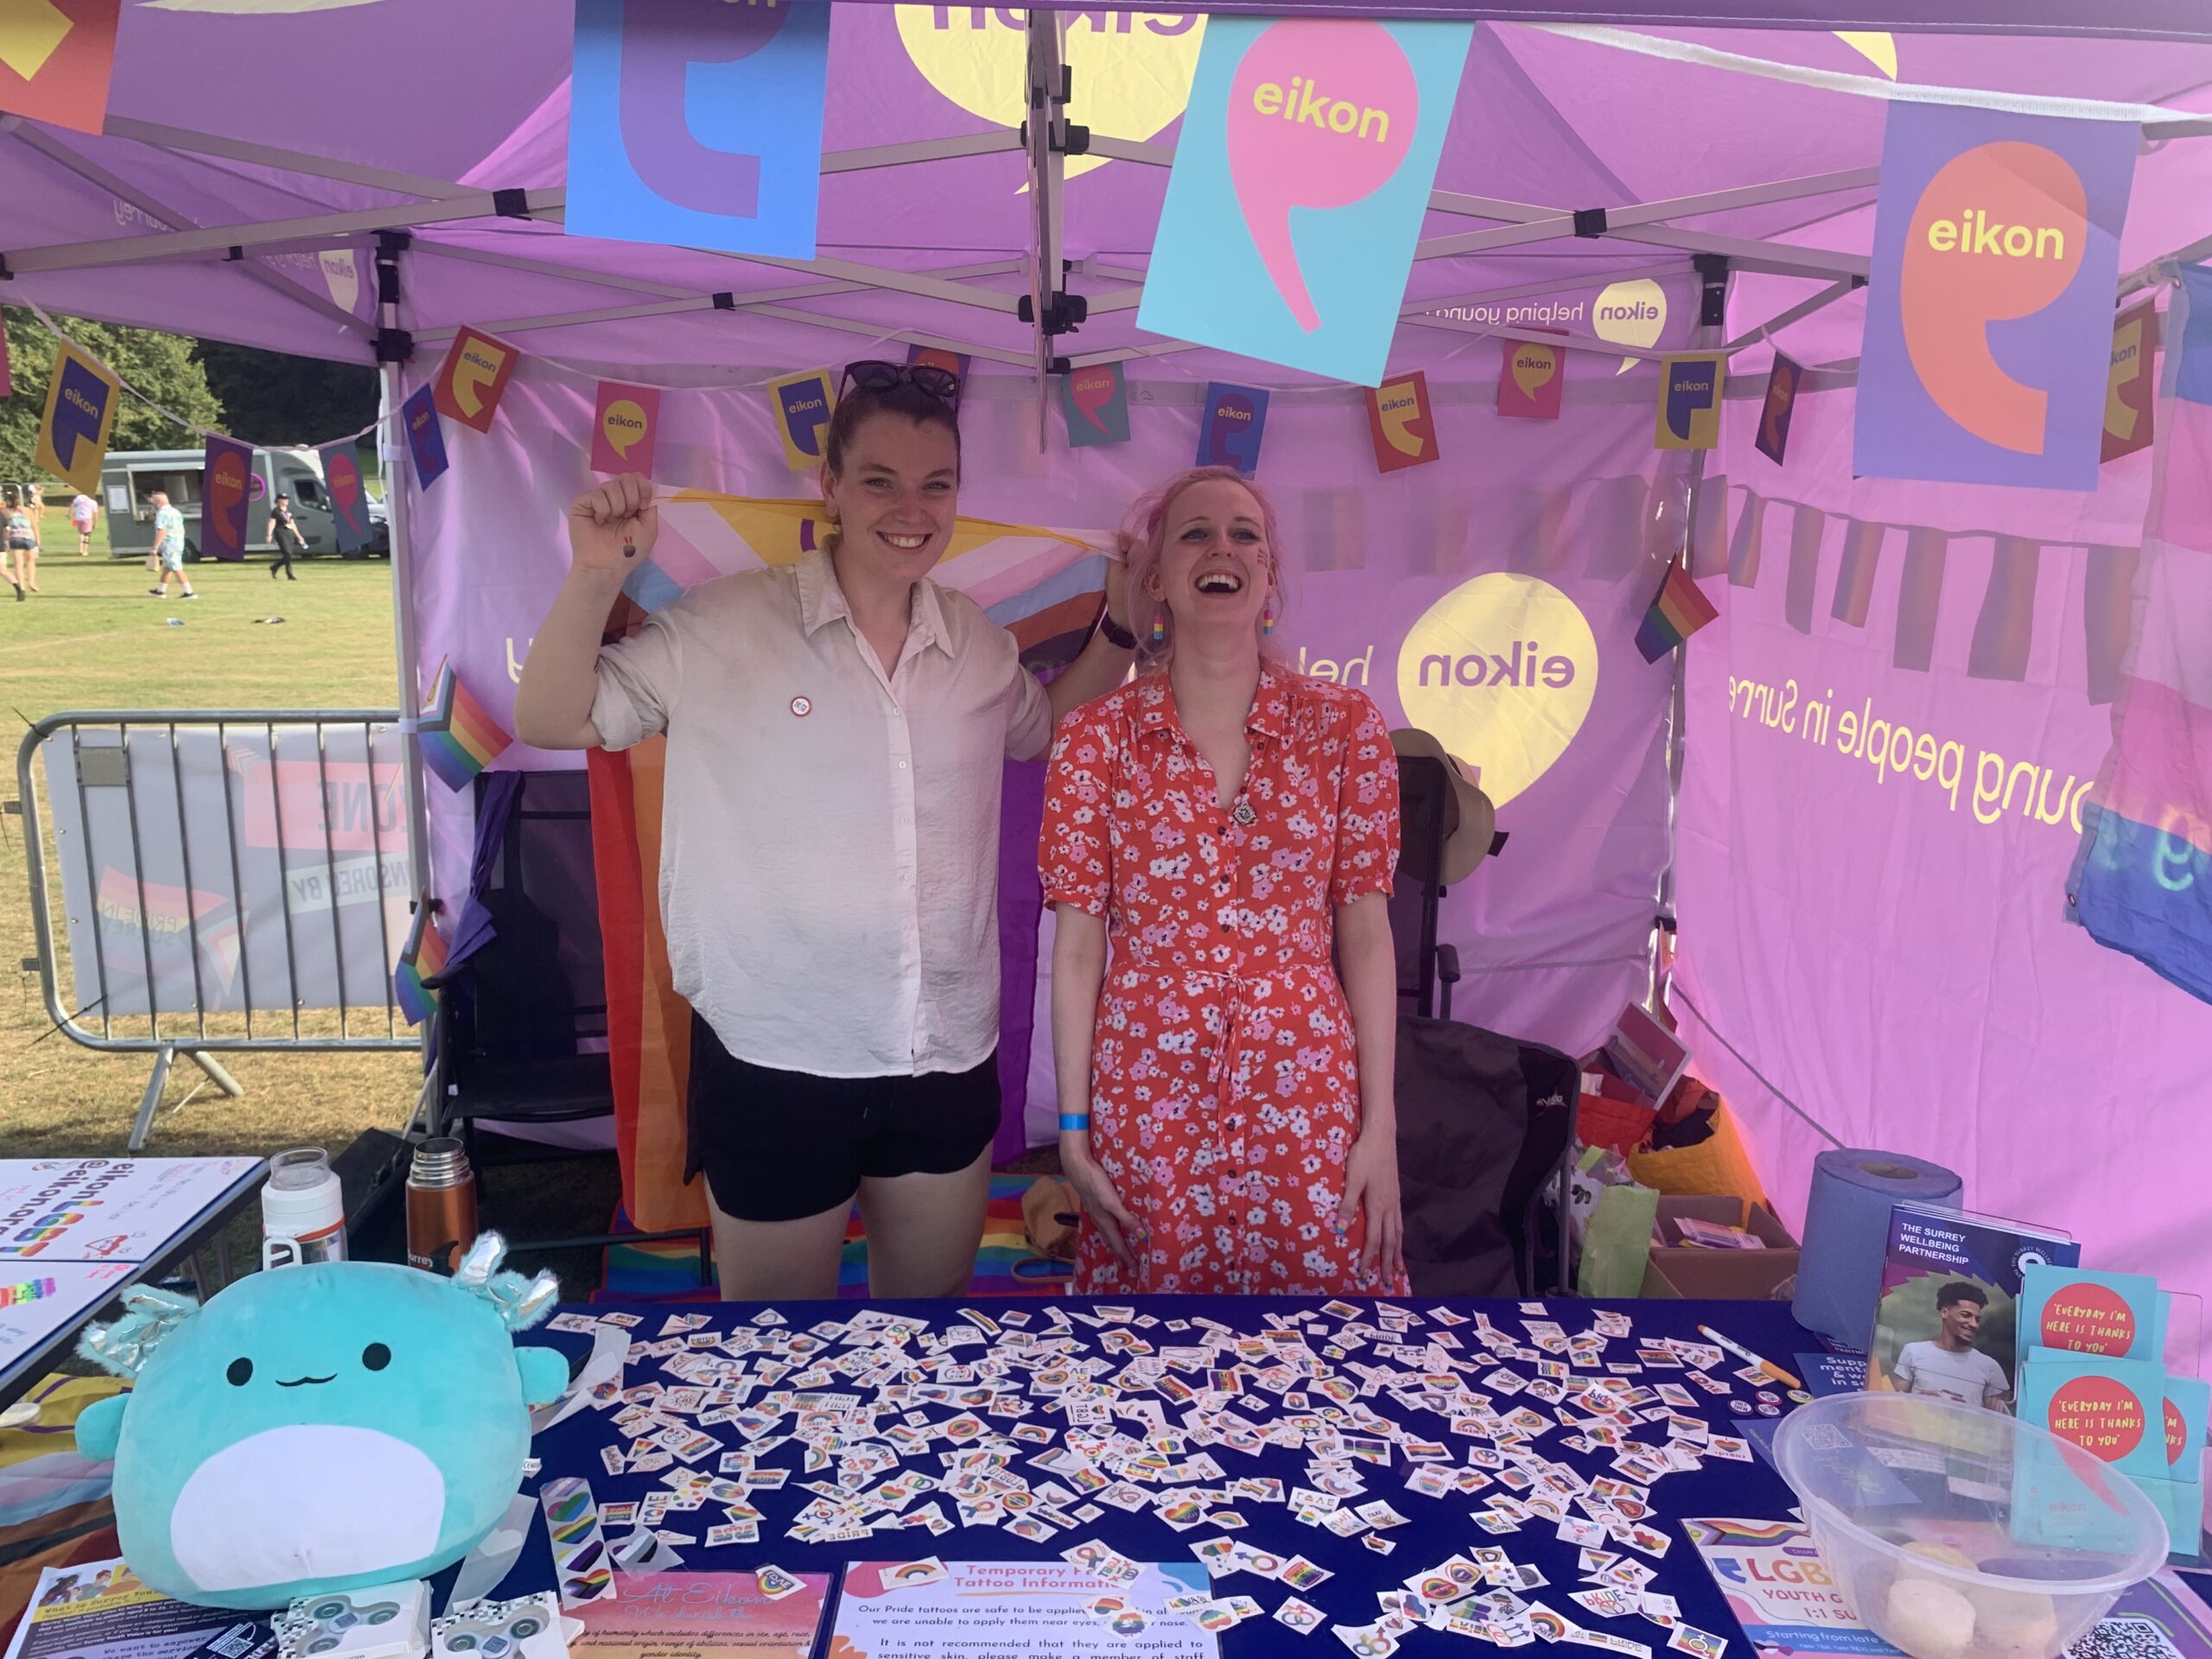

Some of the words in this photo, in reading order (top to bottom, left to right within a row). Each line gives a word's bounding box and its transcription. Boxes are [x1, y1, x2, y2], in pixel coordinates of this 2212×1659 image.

[1253, 77, 1389, 142] eikon
[1929, 209, 2064, 259] eikon
[462, 349, 498, 373] eikon
[1516, 357, 1552, 370] eikon
[1075, 377, 1110, 391] eikon
[1674, 379, 1709, 392] eikon
[64, 386, 99, 419] eikon
[788, 395, 823, 414] eikon
[1381, 395, 1415, 412] eikon
[1217, 406, 1252, 421] eikon
[607, 413, 643, 430] eikon
[215, 471, 243, 491] eikon
[71, 1163, 135, 1199] eikon
[1903, 1223, 1922, 1235] THE
[1924, 1227, 1966, 1243] SURREY
[1900, 1233, 1960, 1253] WELLBEING
[1899, 1243, 1969, 1266] PARTNERSHIP
[2046, 1320, 2071, 1333] HERE
[2075, 1324, 2085, 1334] IS
[2090, 1325, 2131, 1339] THANKS
[2068, 1339, 2082, 1351] TO
[2055, 1417, 2079, 1429] HERE
[2085, 1418, 2094, 1428] IS
[2100, 1417, 2141, 1428] THANKS
[2079, 1435, 2093, 1446] TO
[967, 1565, 1065, 1578] Temporary
[954, 1577, 1014, 1588] Tattoo
[1763, 1589, 1825, 1603] YOUTH
[885, 1605, 914, 1614] Pride
[918, 1605, 958, 1614] tattoos
[985, 1605, 1009, 1614] safe
[1028, 1605, 1043, 1614] be
[915, 1617, 954, 1626] unable
[958, 1618, 969, 1626] to
[973, 1618, 1006, 1628] apply
[1010, 1617, 1038, 1626] them
[1072, 1618, 1100, 1628] eyes,
[1766, 1630, 1819, 1642] Starting
[1821, 1631, 1850, 1642] from
[880, 1638, 889, 1647] It
[897, 1638, 906, 1647] is
[914, 1638, 934, 1648] not
[942, 1638, 1031, 1649] recommended
[1039, 1639, 1064, 1649] that
[1072, 1639, 1098, 1650] they
[1135, 1639, 1183, 1650] applied
